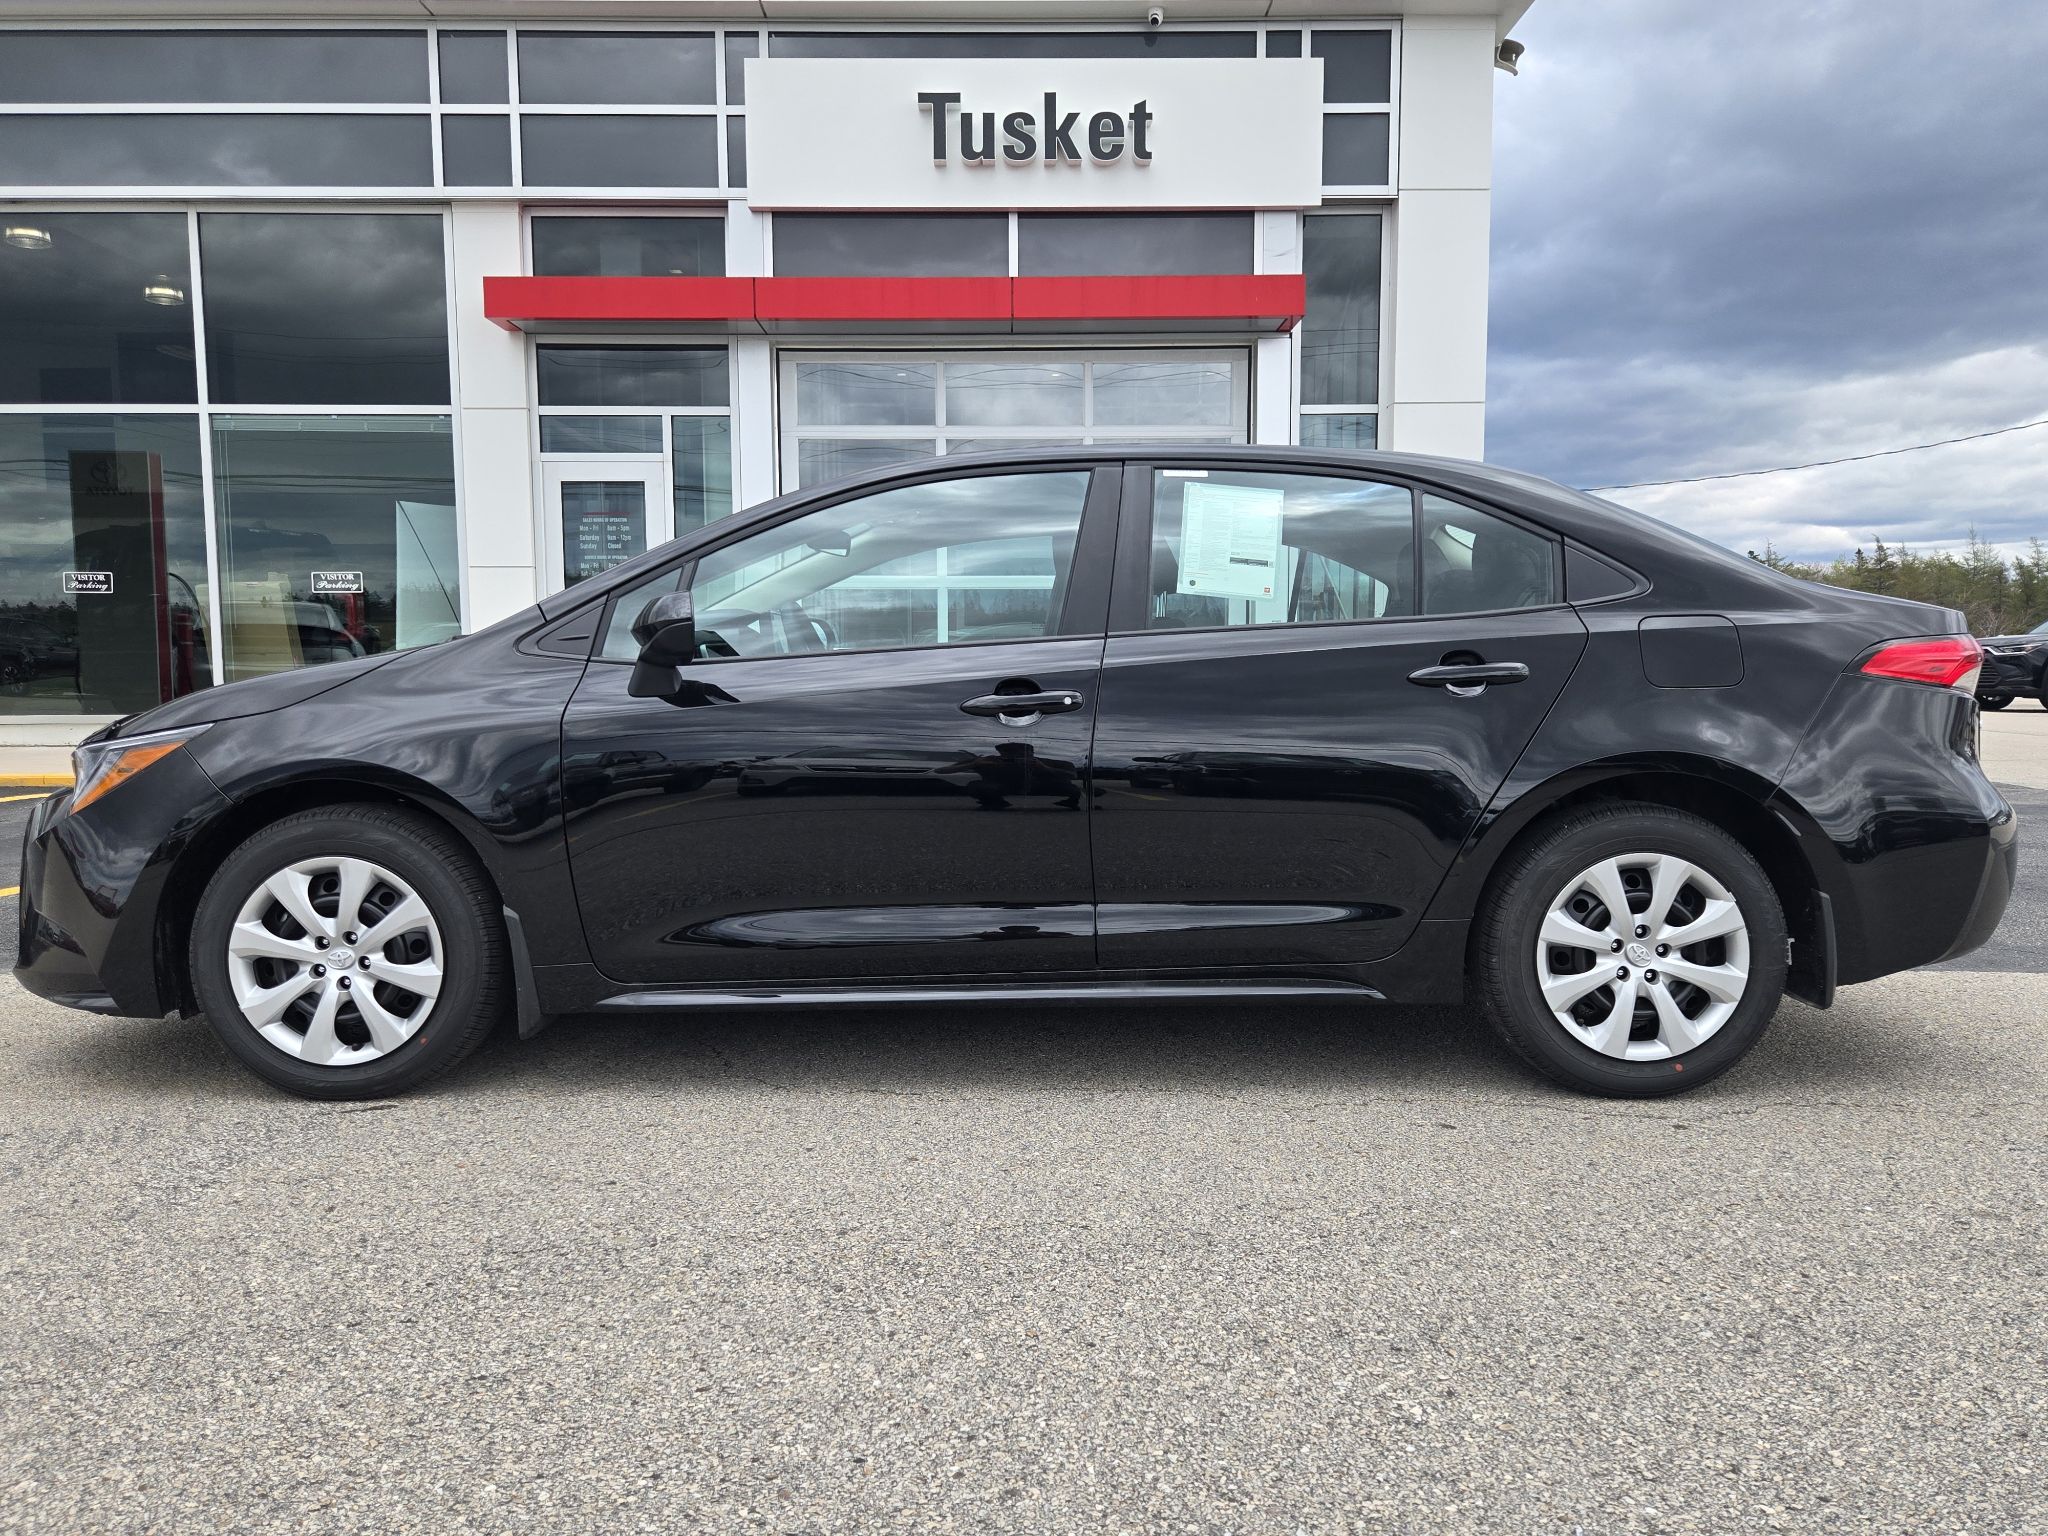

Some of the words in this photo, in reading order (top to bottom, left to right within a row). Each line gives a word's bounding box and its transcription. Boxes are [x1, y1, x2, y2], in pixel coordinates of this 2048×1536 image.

[917, 91, 1153, 165] Tusket
[620, 524, 630, 532] 5pm
[579, 534, 600, 542] Saturday
[620, 534, 632, 542] 12pm
[579, 542, 597, 550] Sunday
[67, 581, 108, 591] Parking
[315, 581, 360, 591] Parking
